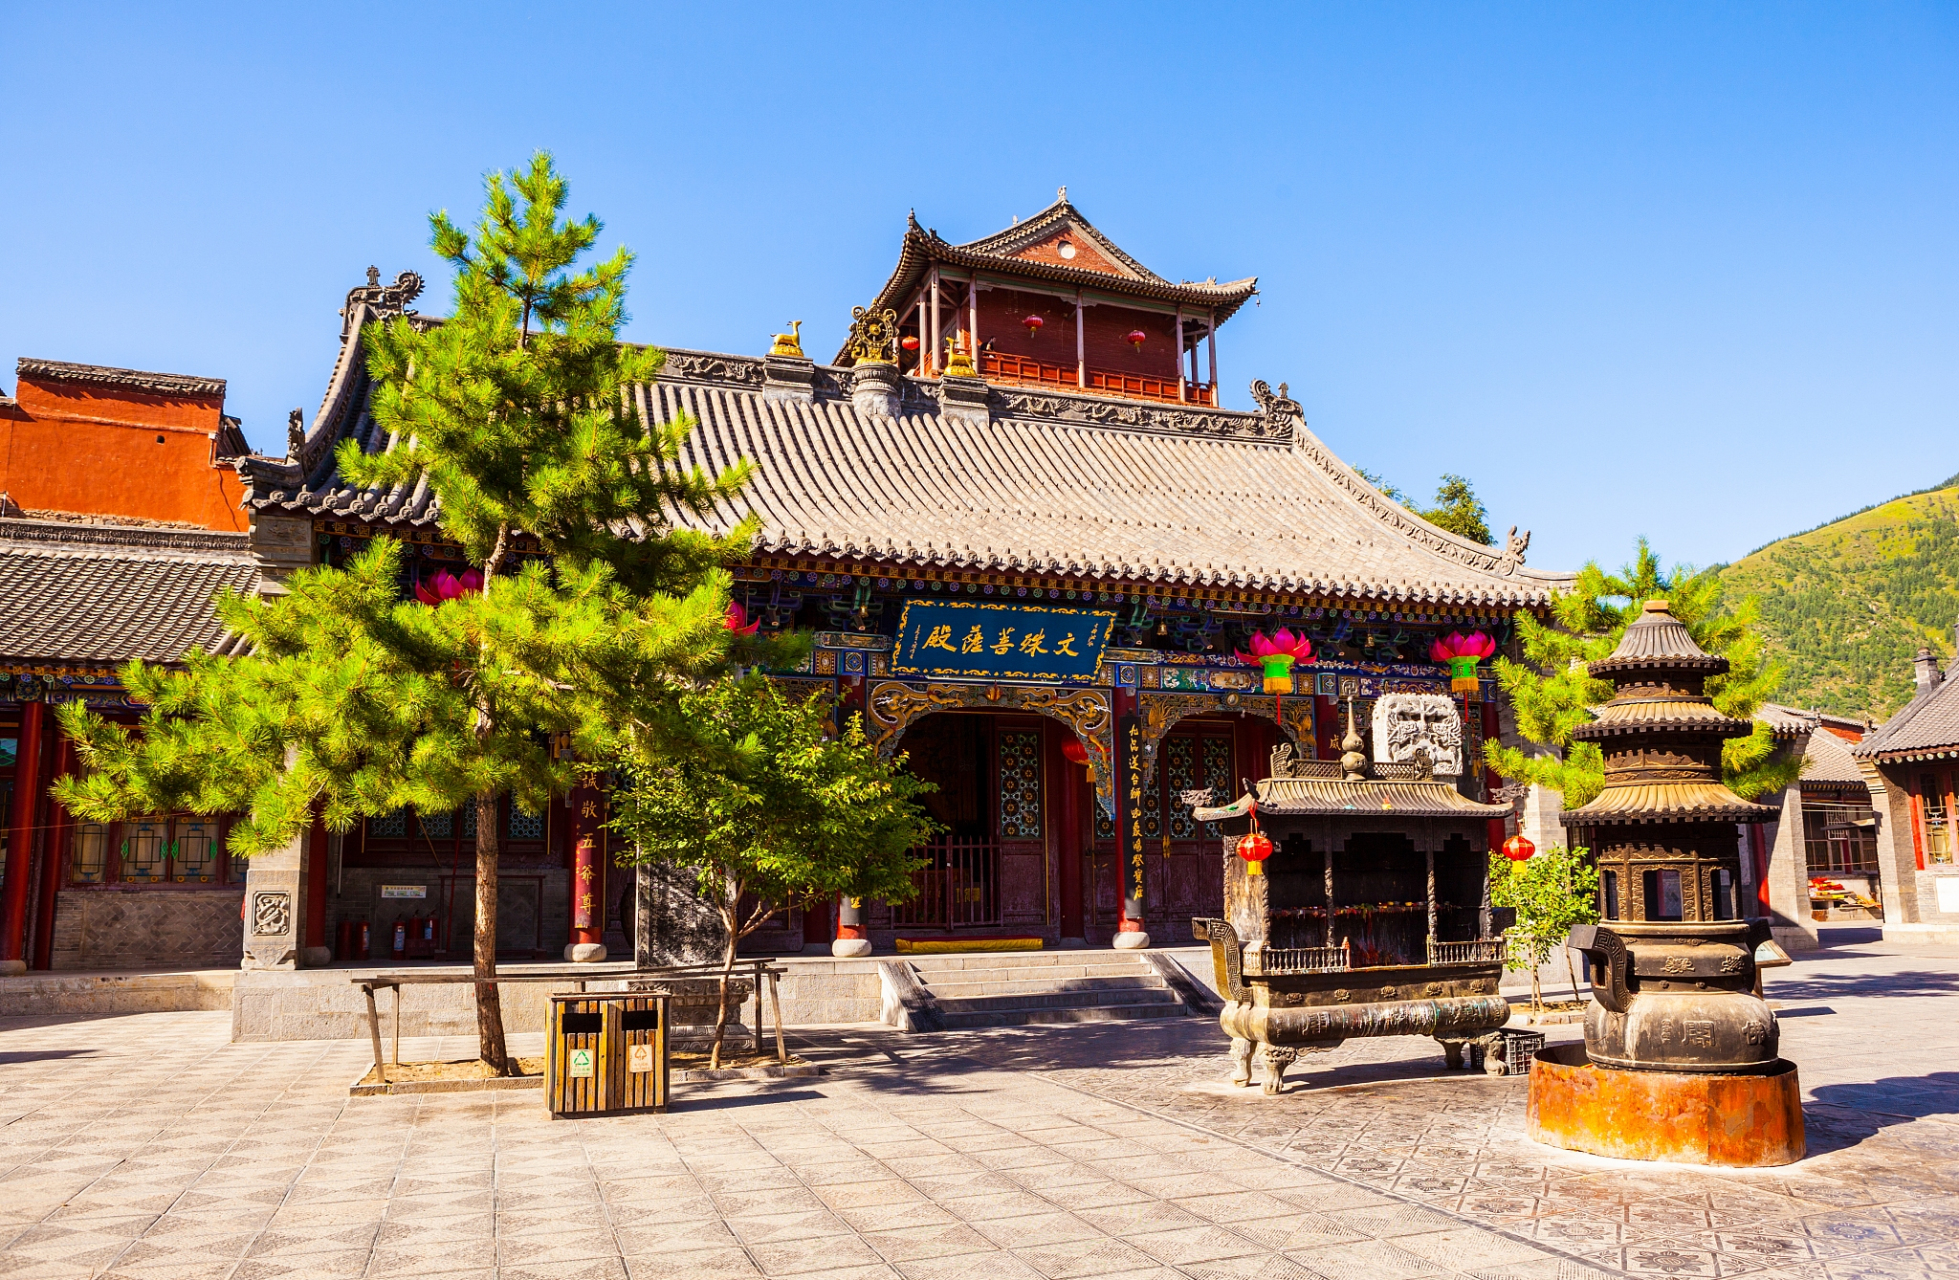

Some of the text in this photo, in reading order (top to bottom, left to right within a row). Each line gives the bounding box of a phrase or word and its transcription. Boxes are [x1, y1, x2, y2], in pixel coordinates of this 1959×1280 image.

[920, 624, 1079, 657] 文殊菩薩殿
